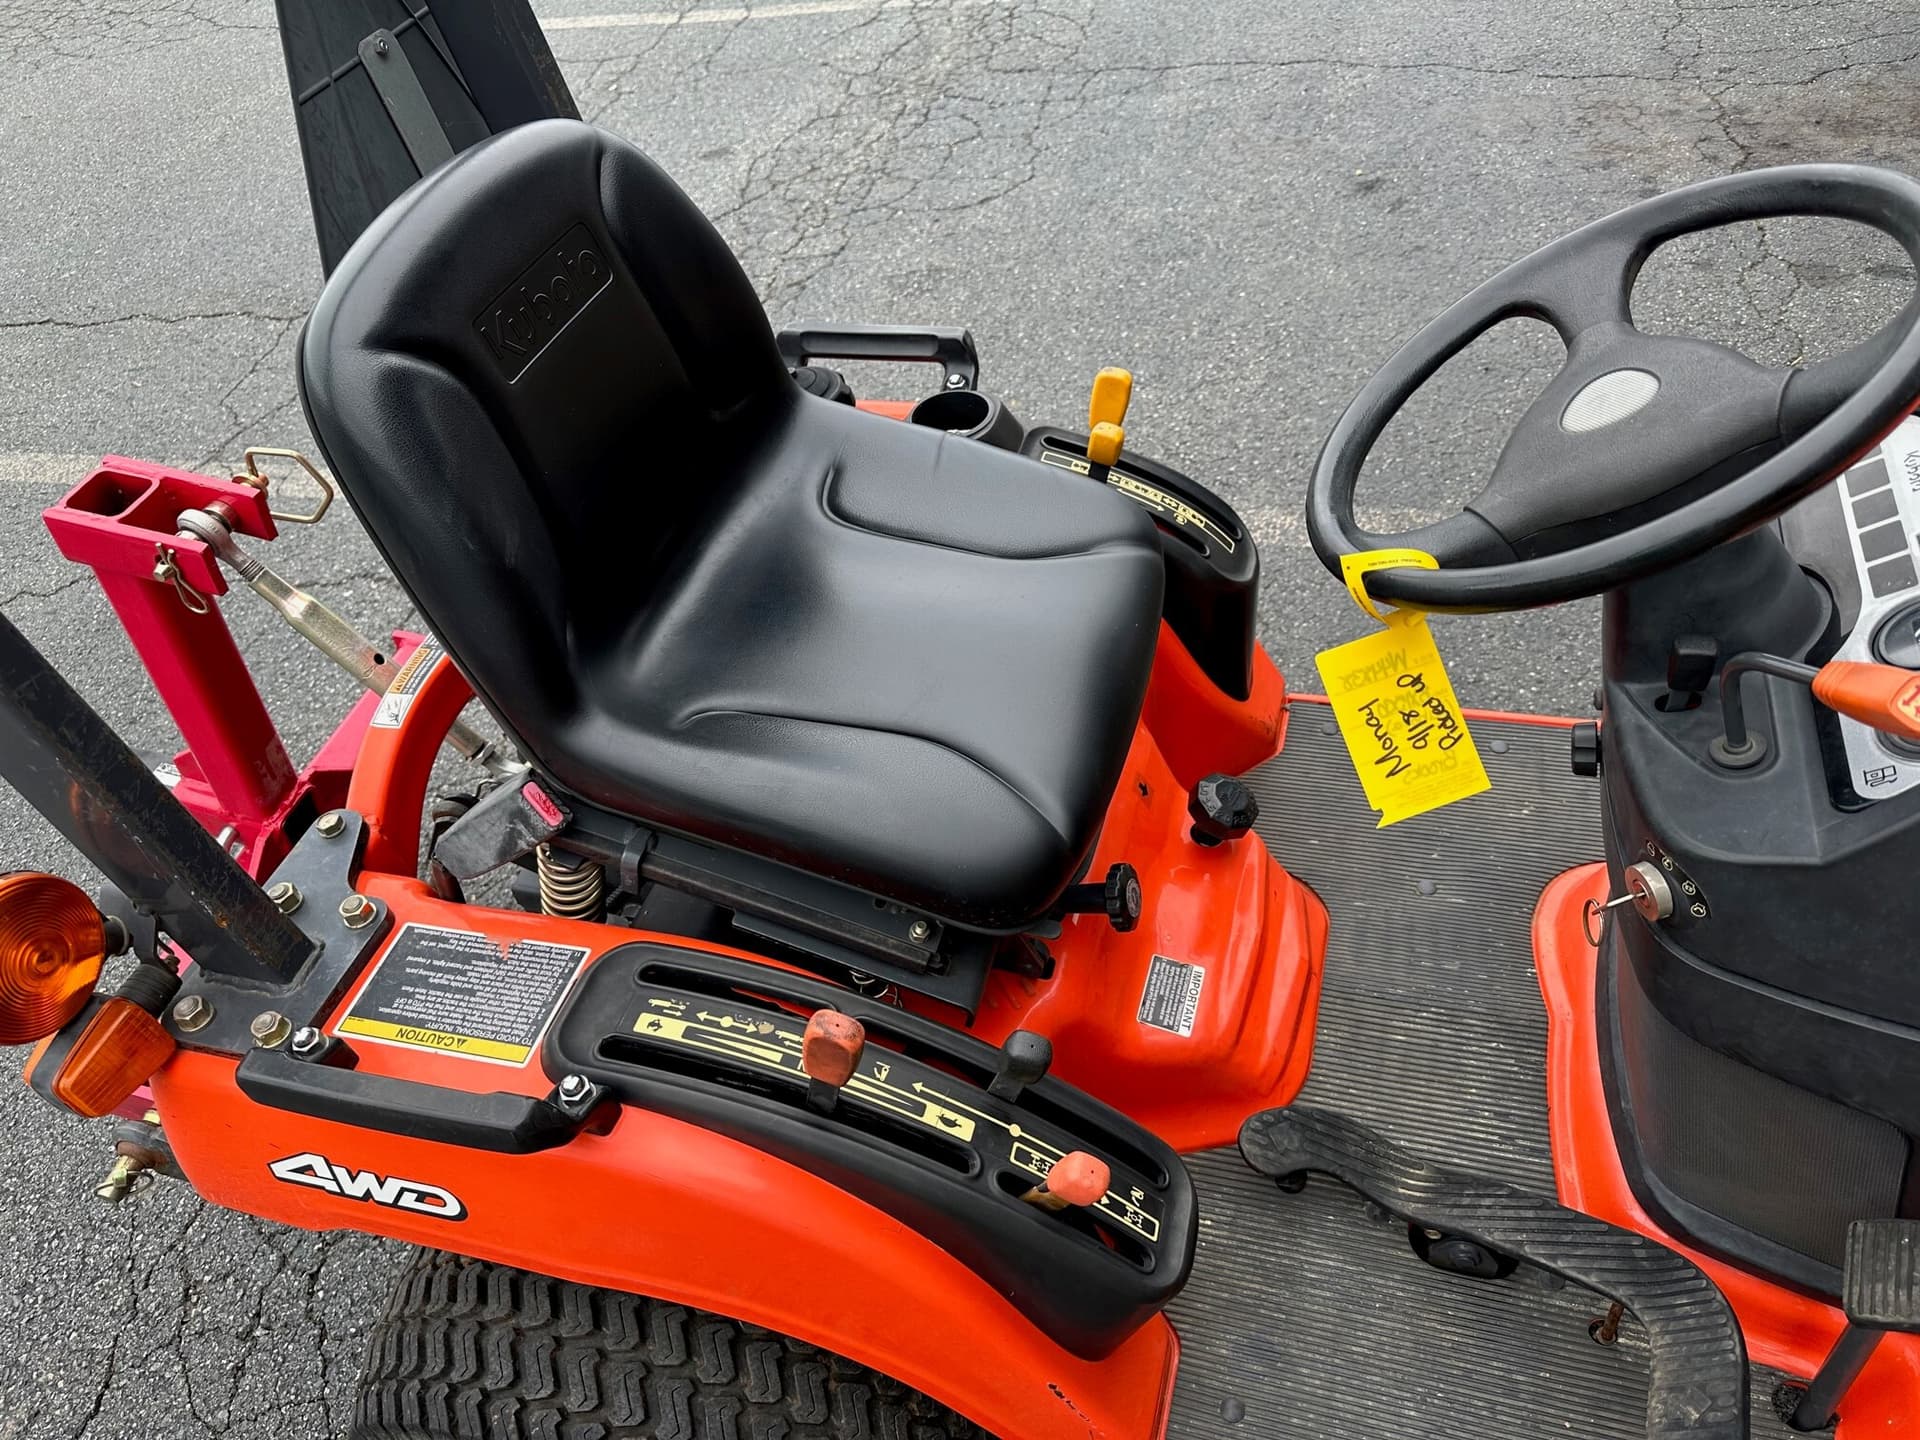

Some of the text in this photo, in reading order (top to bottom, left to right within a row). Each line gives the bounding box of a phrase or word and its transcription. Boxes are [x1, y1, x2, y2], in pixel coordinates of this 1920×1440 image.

[480, 249, 597, 360] Kubota
[397, 648, 428, 686] WARNING
[1180, 970, 1202, 1030] IMPORTANT
[394, 1027, 456, 1046] CAUTION
[453, 1025, 496, 1038] PERSONAL
[495, 1033, 521, 1042] AVOID
[520, 1037, 534, 1045] TO
